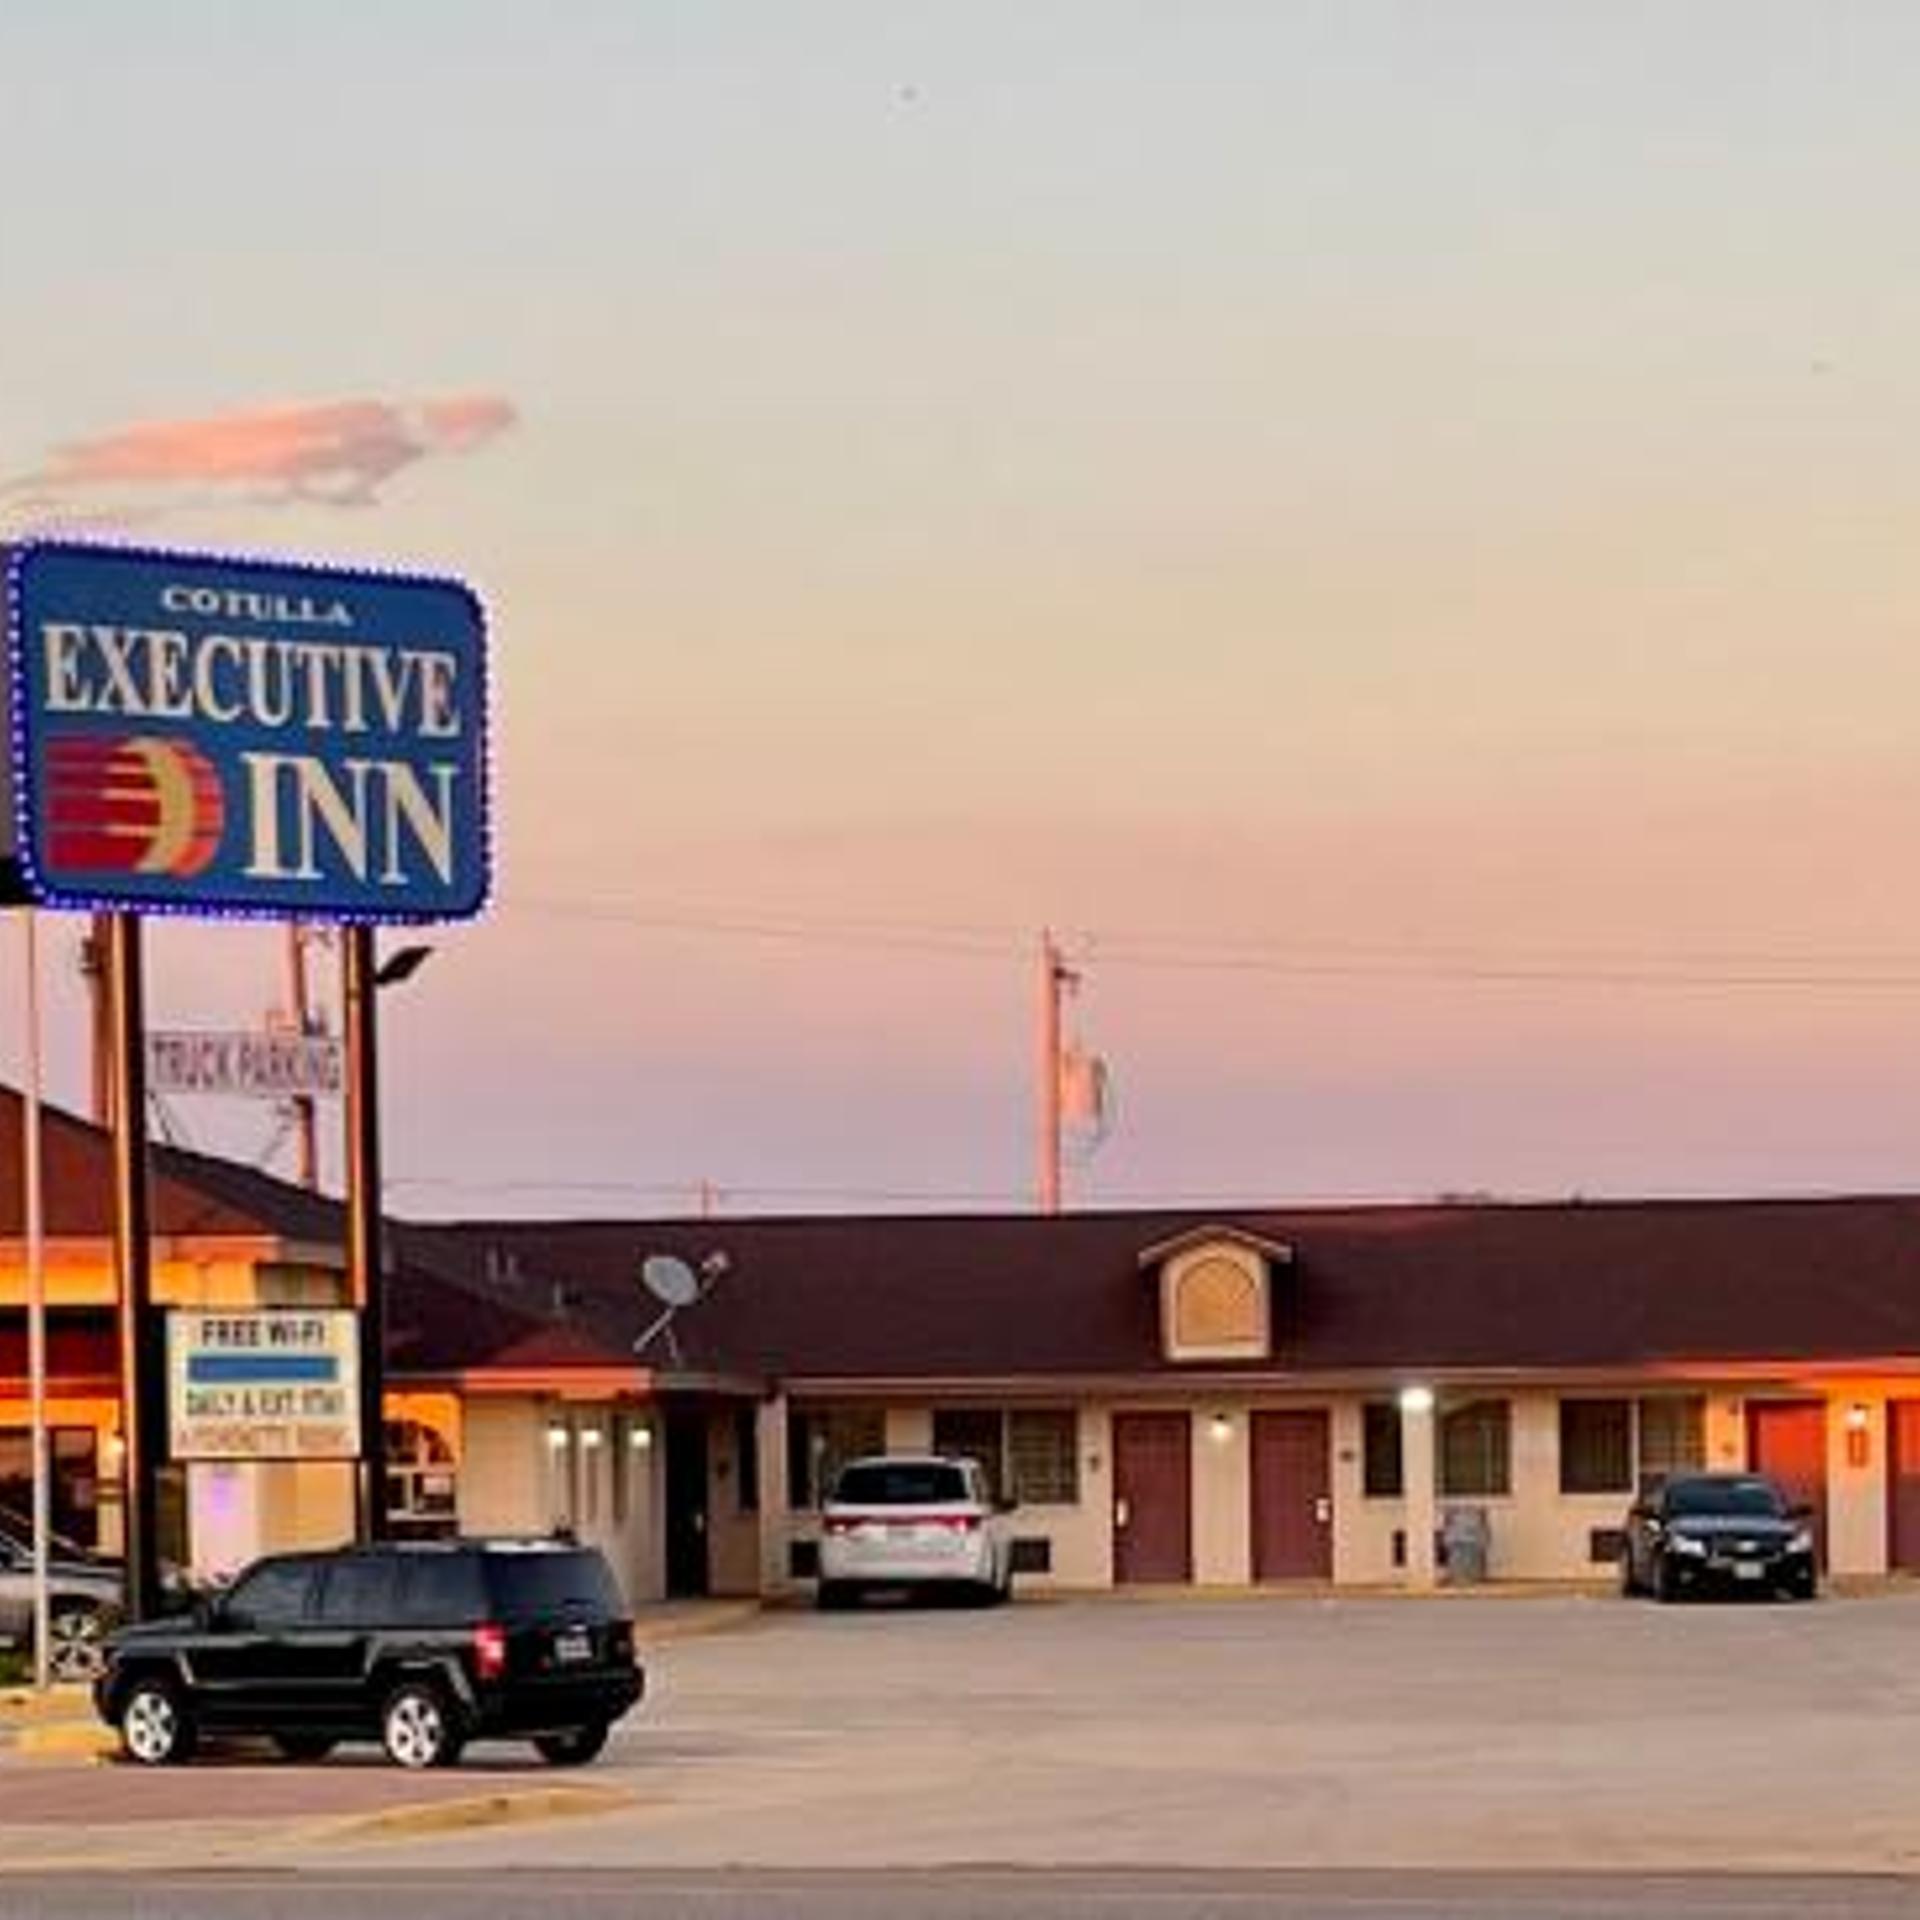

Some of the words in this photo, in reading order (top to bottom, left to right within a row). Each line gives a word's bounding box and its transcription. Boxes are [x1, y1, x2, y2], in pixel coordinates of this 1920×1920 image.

[161, 584, 354, 627] COTULLA
[41, 623, 462, 738] EXECUTIVE
[240, 749, 459, 887] INN
[154, 1038, 235, 1087] TRUCK
[202, 1319, 260, 1346] FREE
